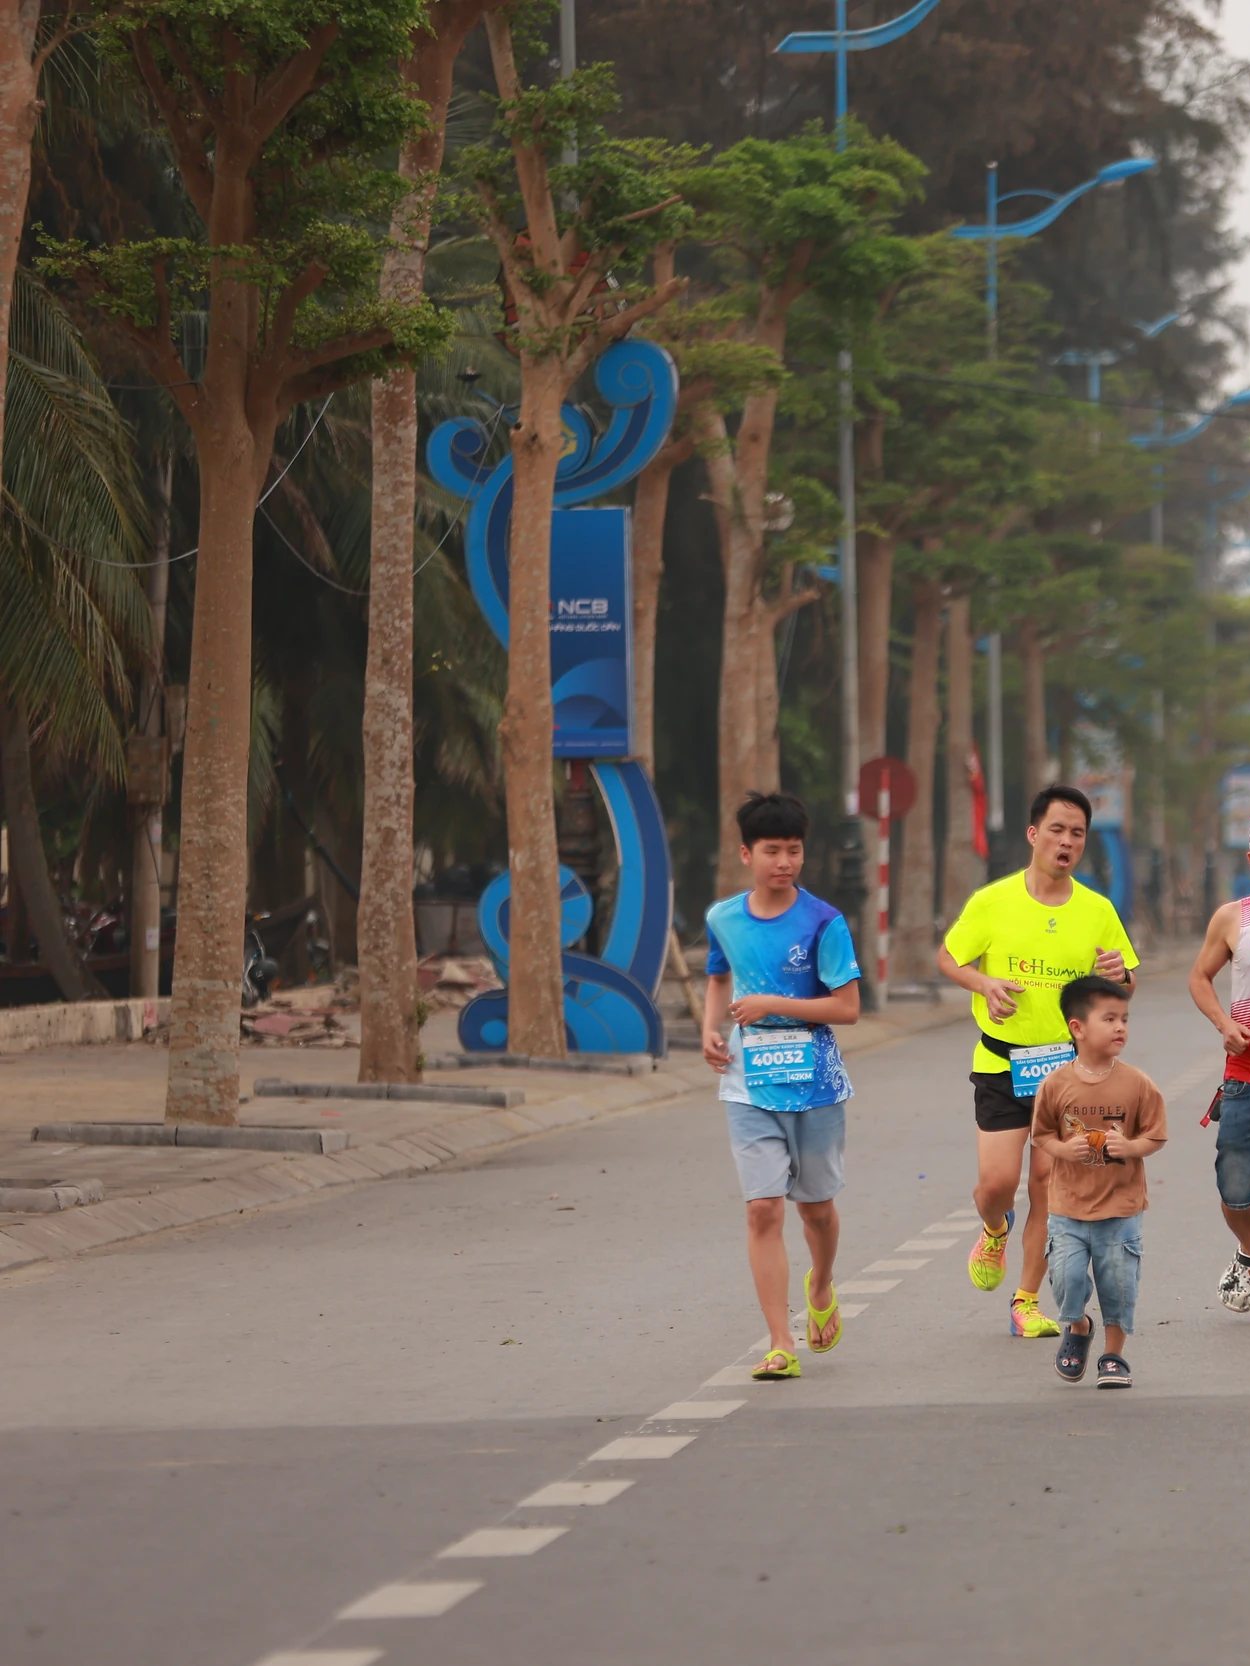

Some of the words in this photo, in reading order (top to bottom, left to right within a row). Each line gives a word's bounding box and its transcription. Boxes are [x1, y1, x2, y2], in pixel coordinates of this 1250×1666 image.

[558, 598, 609, 615] NCB
[752, 1050, 804, 1066] 40032
[1066, 1106, 1122, 1115] TROUBLE
